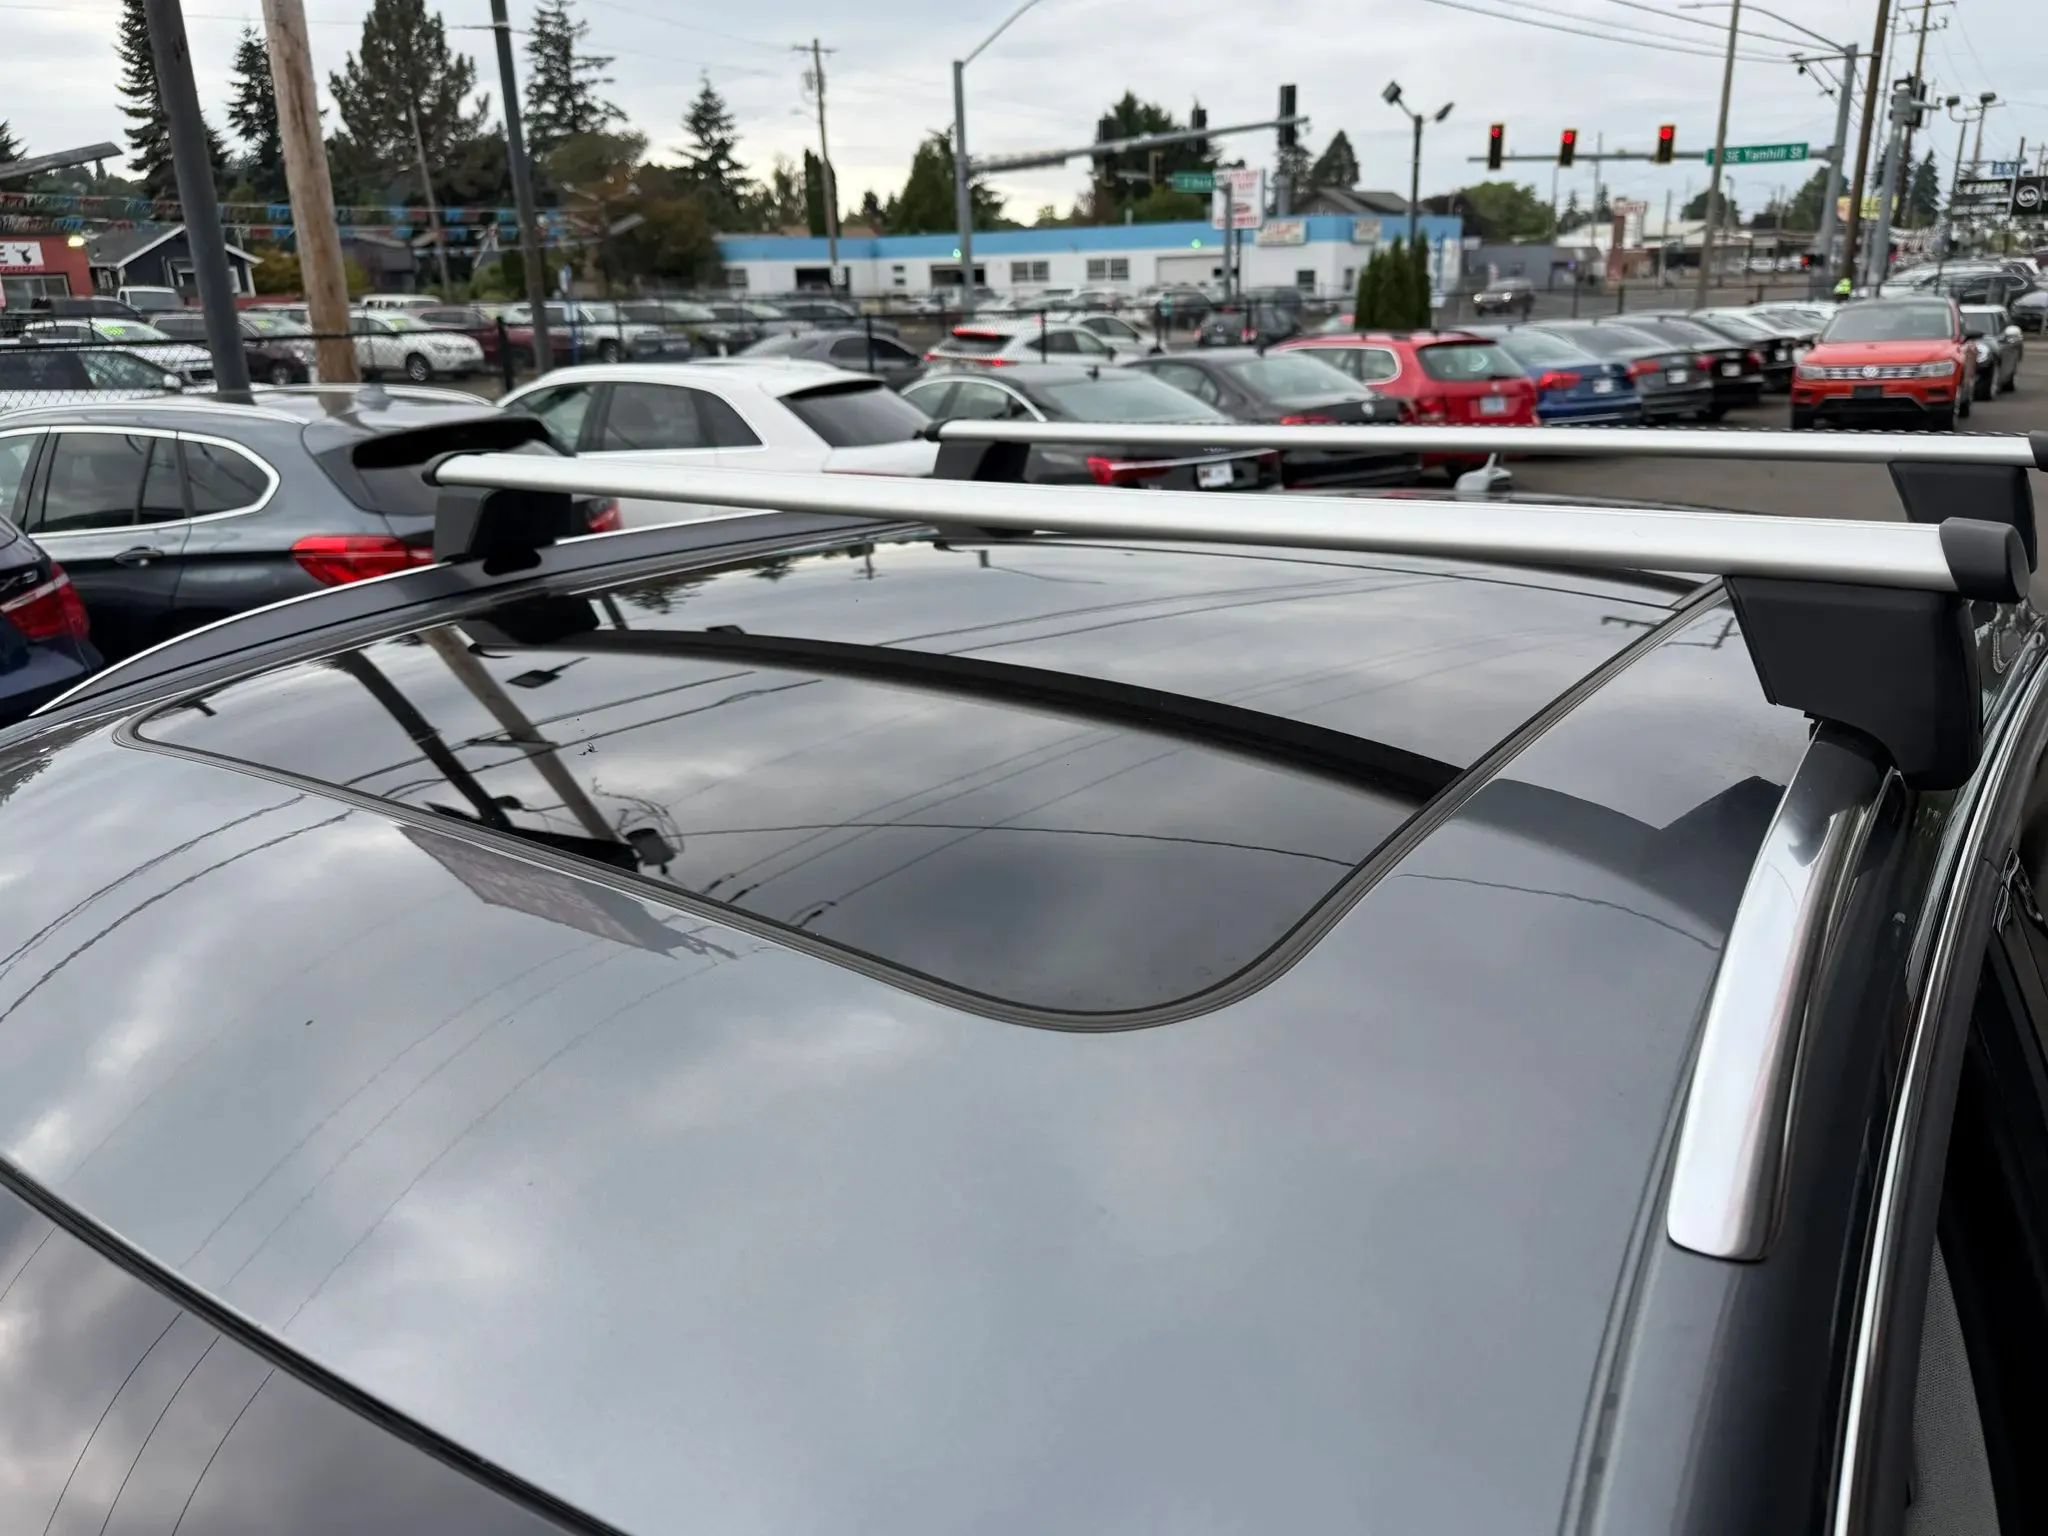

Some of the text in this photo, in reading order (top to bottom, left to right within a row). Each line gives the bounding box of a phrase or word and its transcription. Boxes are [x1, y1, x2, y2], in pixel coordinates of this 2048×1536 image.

[1726, 146, 1803, 161] SE Yamhill St
